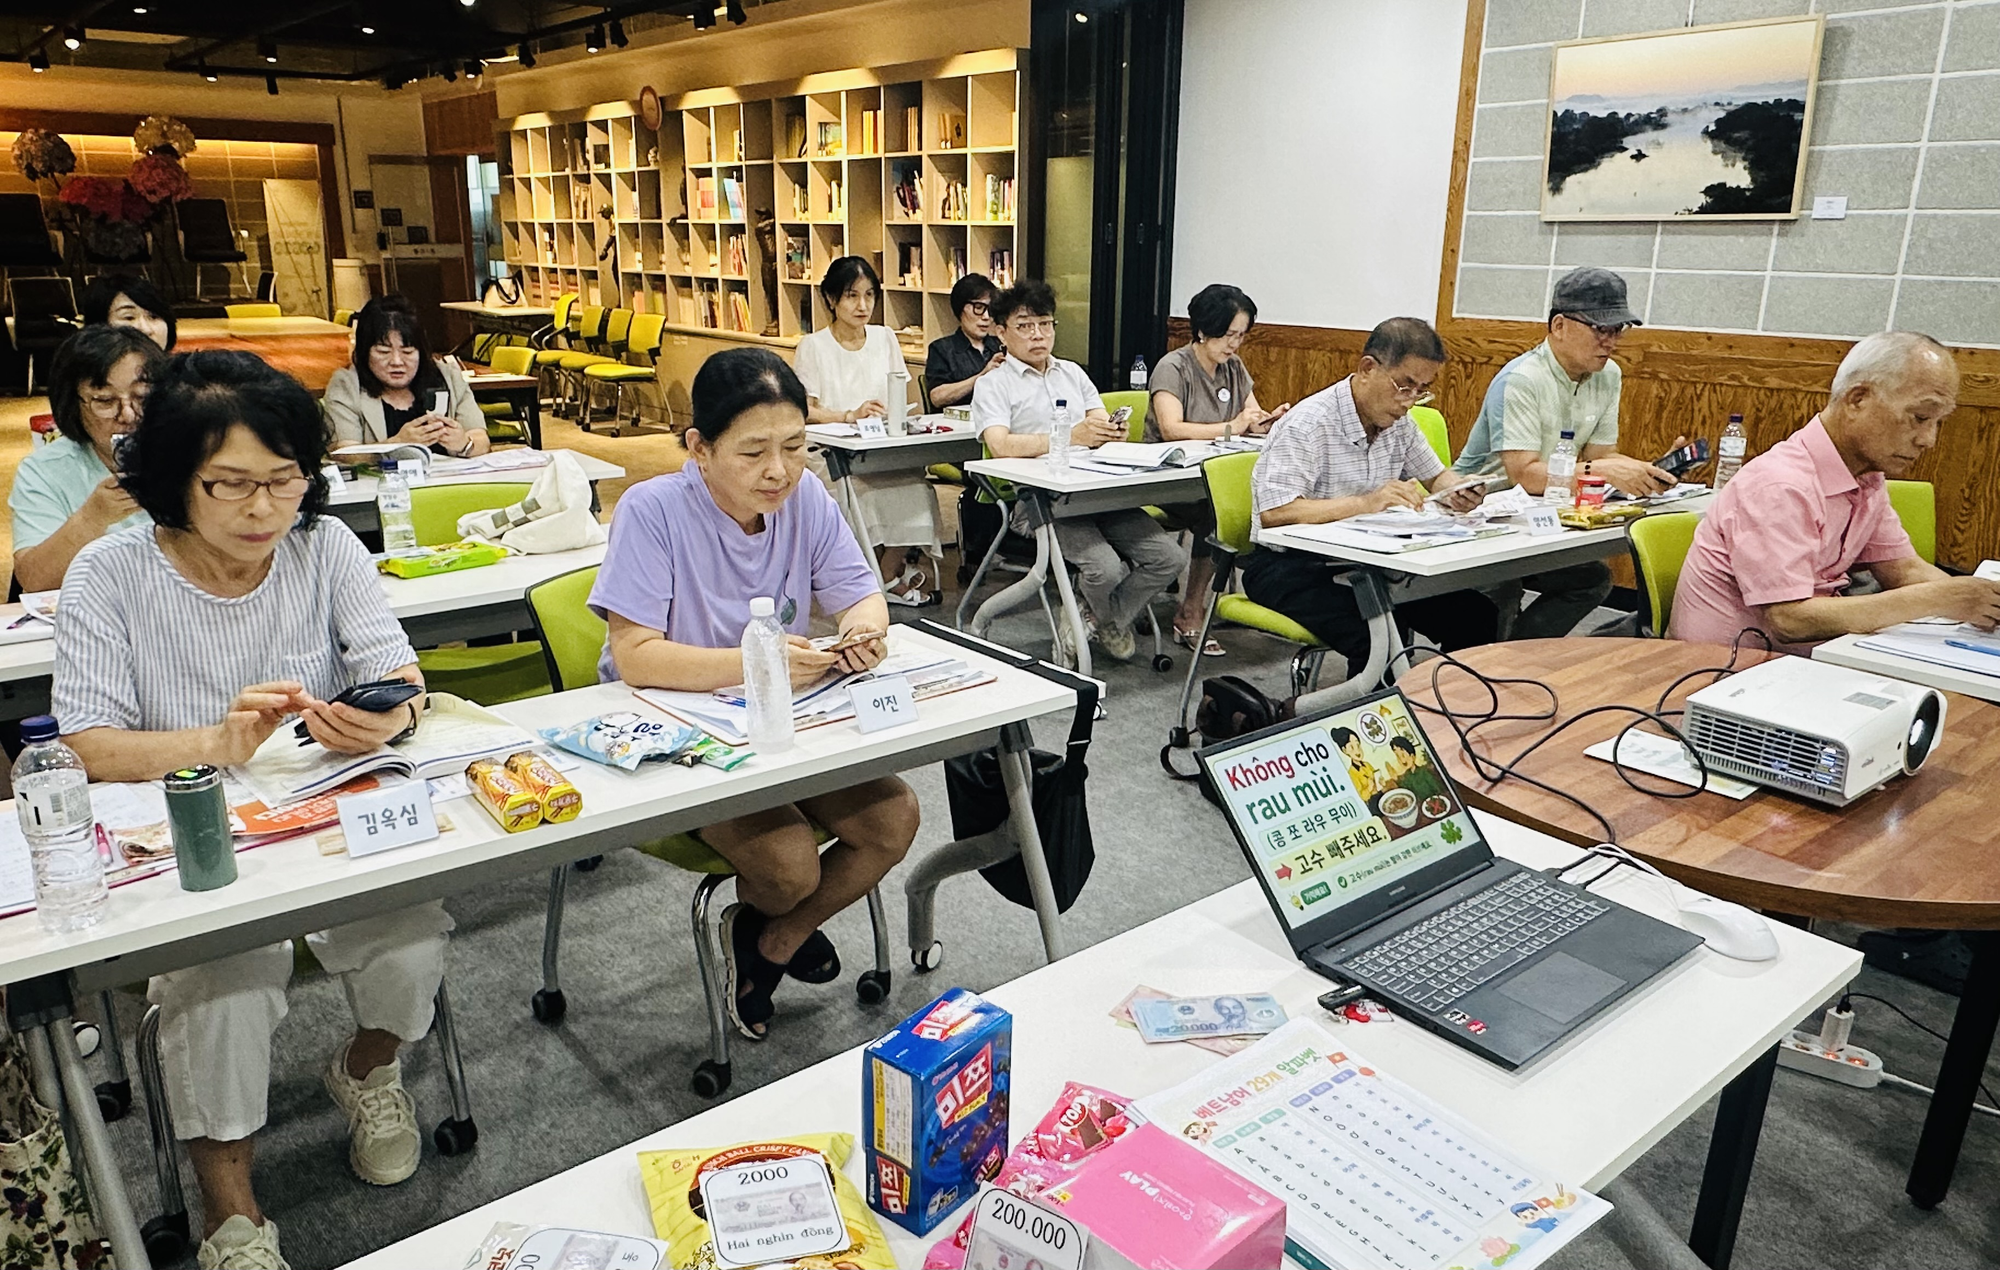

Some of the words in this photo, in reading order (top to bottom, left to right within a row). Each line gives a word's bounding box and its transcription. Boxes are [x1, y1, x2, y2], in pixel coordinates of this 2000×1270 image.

[872, 695, 899, 713] 이진
[1224, 757, 1296, 791] Không
[1295, 741, 1330, 768] cho
[1245, 790, 1292, 825] rau
[1291, 767, 1346, 808] mùi.
[357, 803, 419, 836] 김옥심
[1288, 824, 1303, 843] 쪼
[1302, 812, 1327, 836] 라우
[1328, 801, 1358, 825] 무이)
[1294, 849, 1326, 875] 고수
[1325, 825, 1388, 860] 빼주세요.
[937, 1054, 990, 1126] 미쯔
[1193, 1086, 1252, 1119] 베트남어
[1246, 1070, 1284, 1093] 29개
[1276, 1047, 1322, 1075] 알파벳
[753, 1145, 789, 1153] CRISPY
[737, 1166, 788, 1186] 2000
[881, 1164, 903, 1214] 미쯔
[1119, 1170, 1161, 1197] PLAY
[727, 1238, 750, 1251] Hai
[992, 1198, 1066, 1249] 200.000
